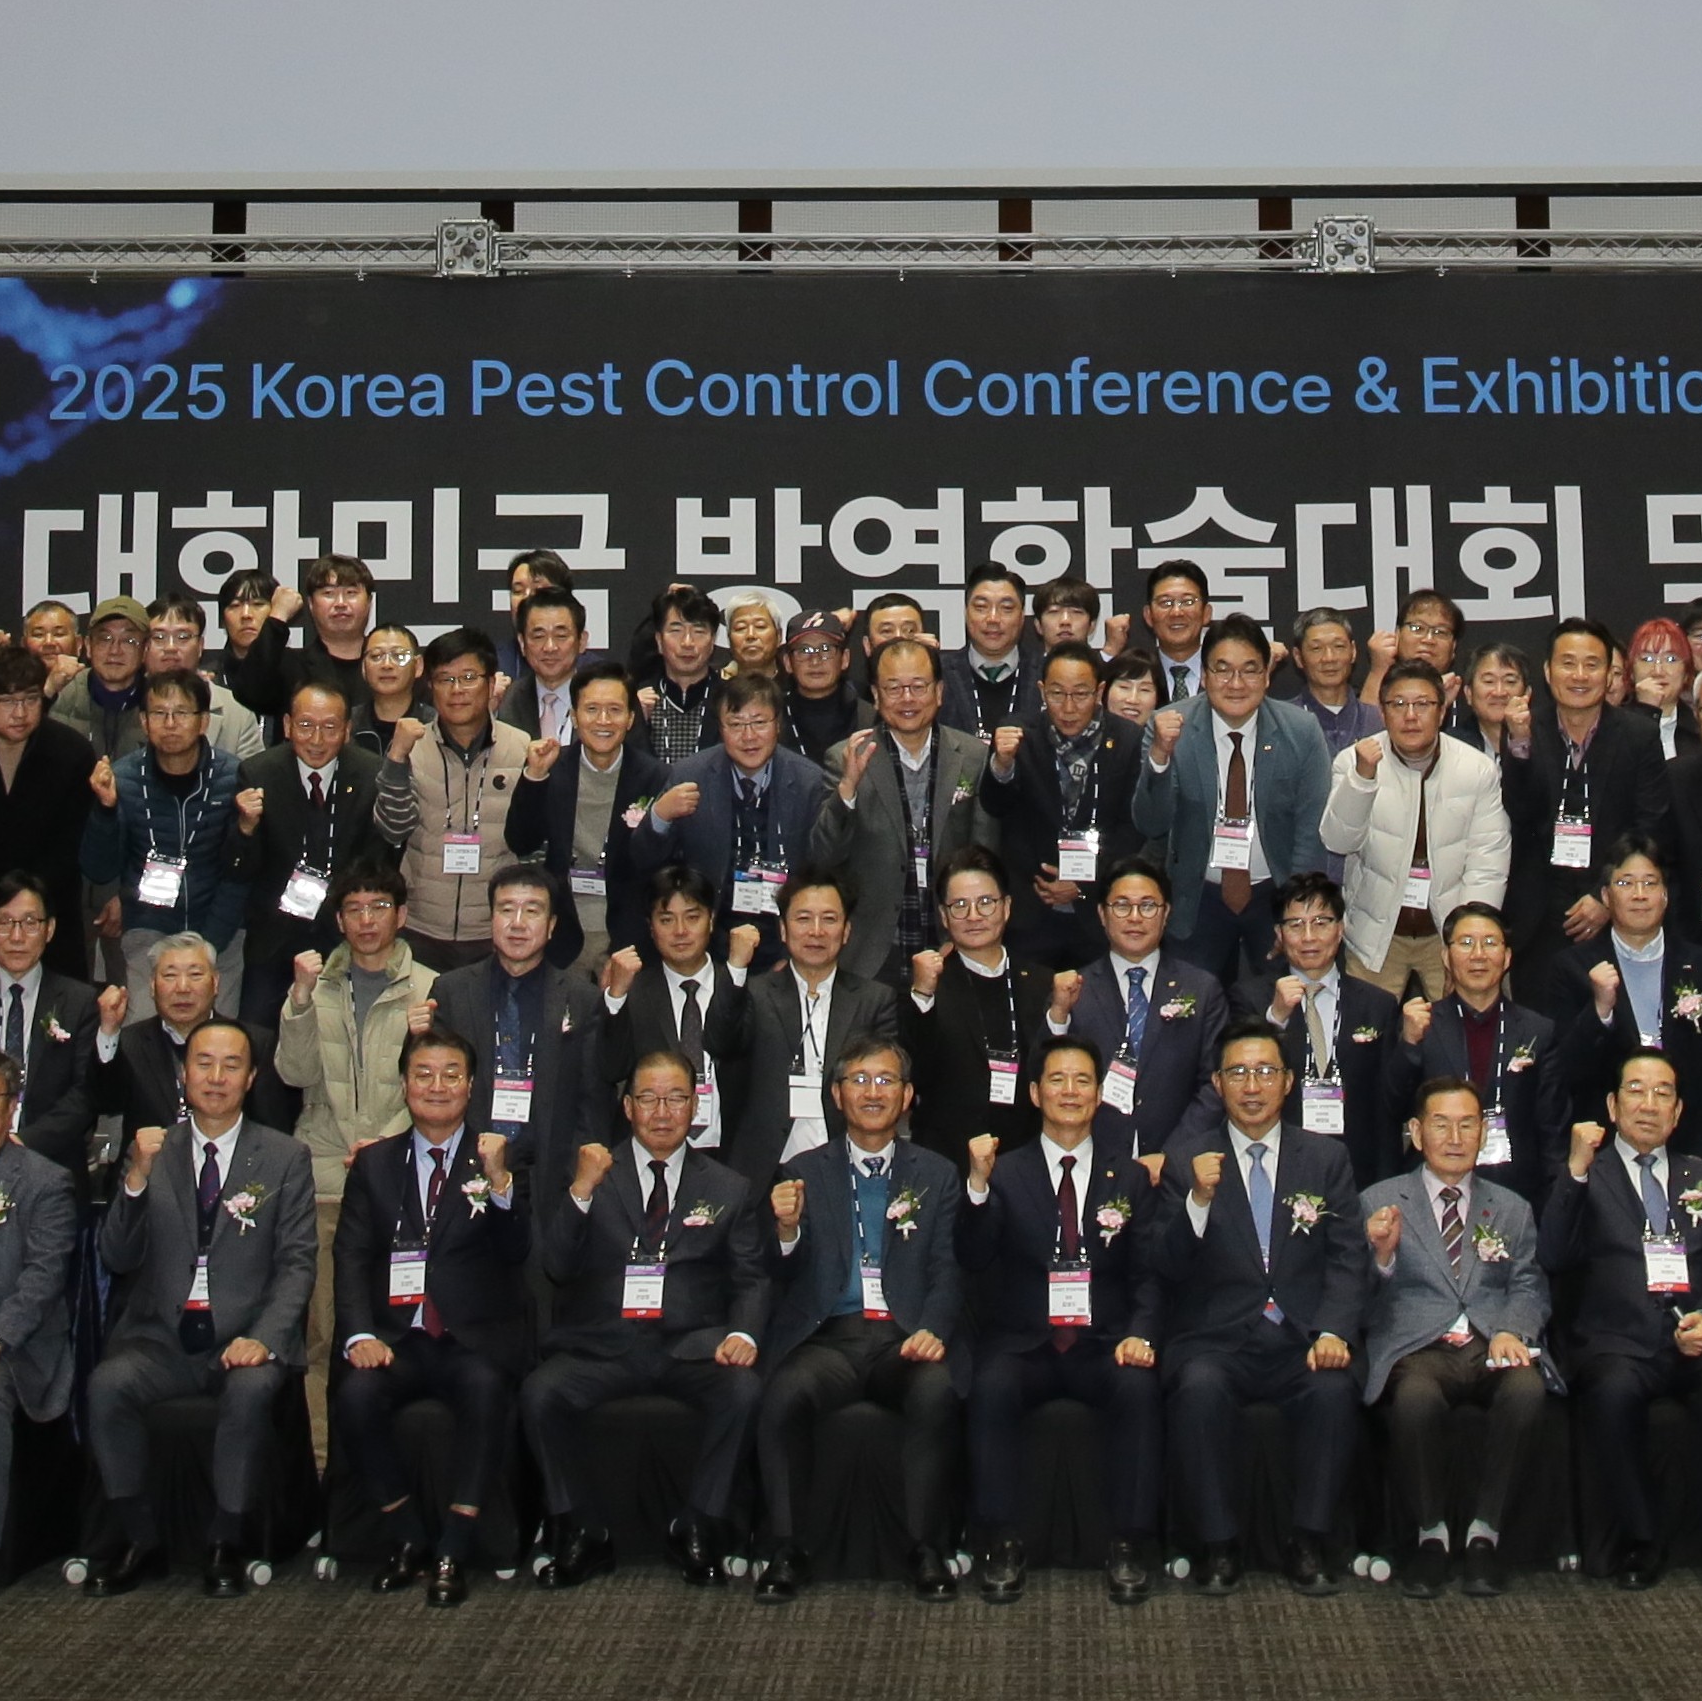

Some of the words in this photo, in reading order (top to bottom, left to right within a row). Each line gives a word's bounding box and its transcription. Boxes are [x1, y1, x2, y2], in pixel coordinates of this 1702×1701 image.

[48, 363, 227, 421] 2025
[252, 362, 447, 420] Korea
[471, 359, 624, 417] Pest
[644, 358, 900, 418] Control
[923, 355, 1333, 417] Conference
[1354, 355, 1402, 415] &
